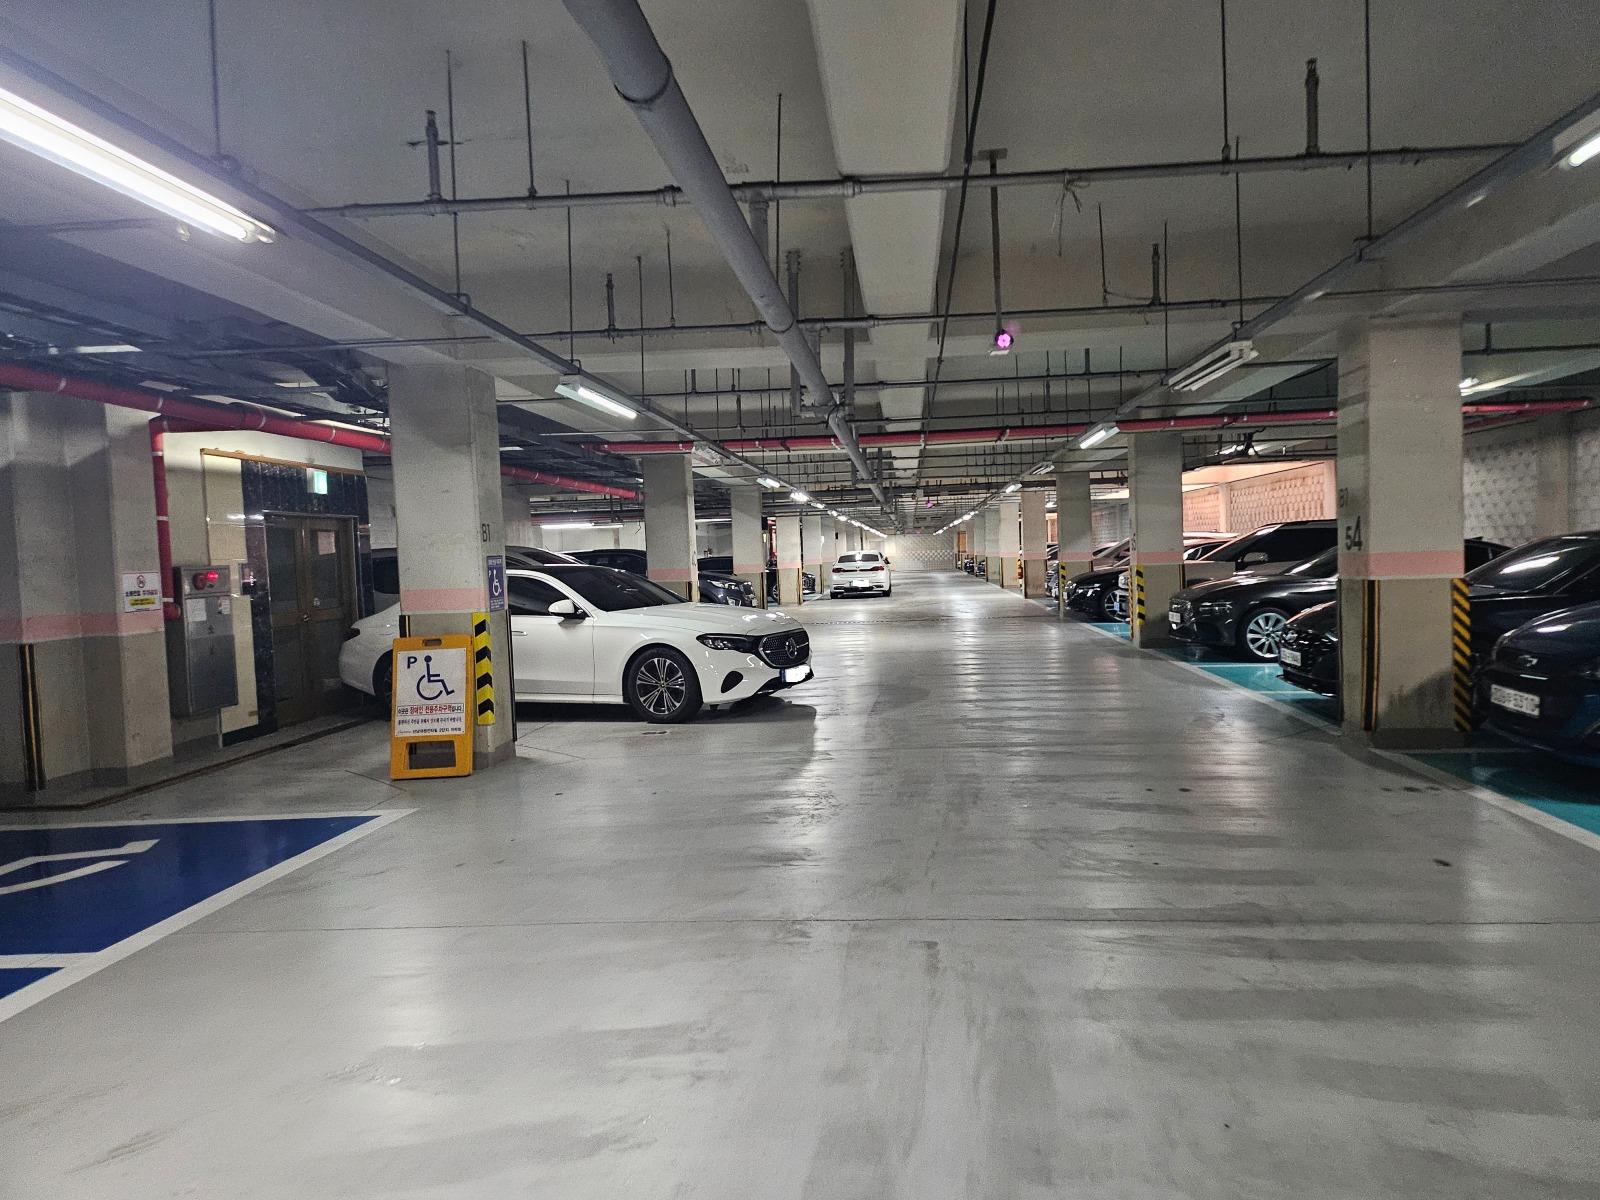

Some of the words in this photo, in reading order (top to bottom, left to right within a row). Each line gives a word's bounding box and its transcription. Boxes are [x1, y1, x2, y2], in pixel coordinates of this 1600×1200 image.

[1345, 515, 1363, 551] 54
[407, 656, 417, 669] P
[410, 705, 423, 714] 장애인
